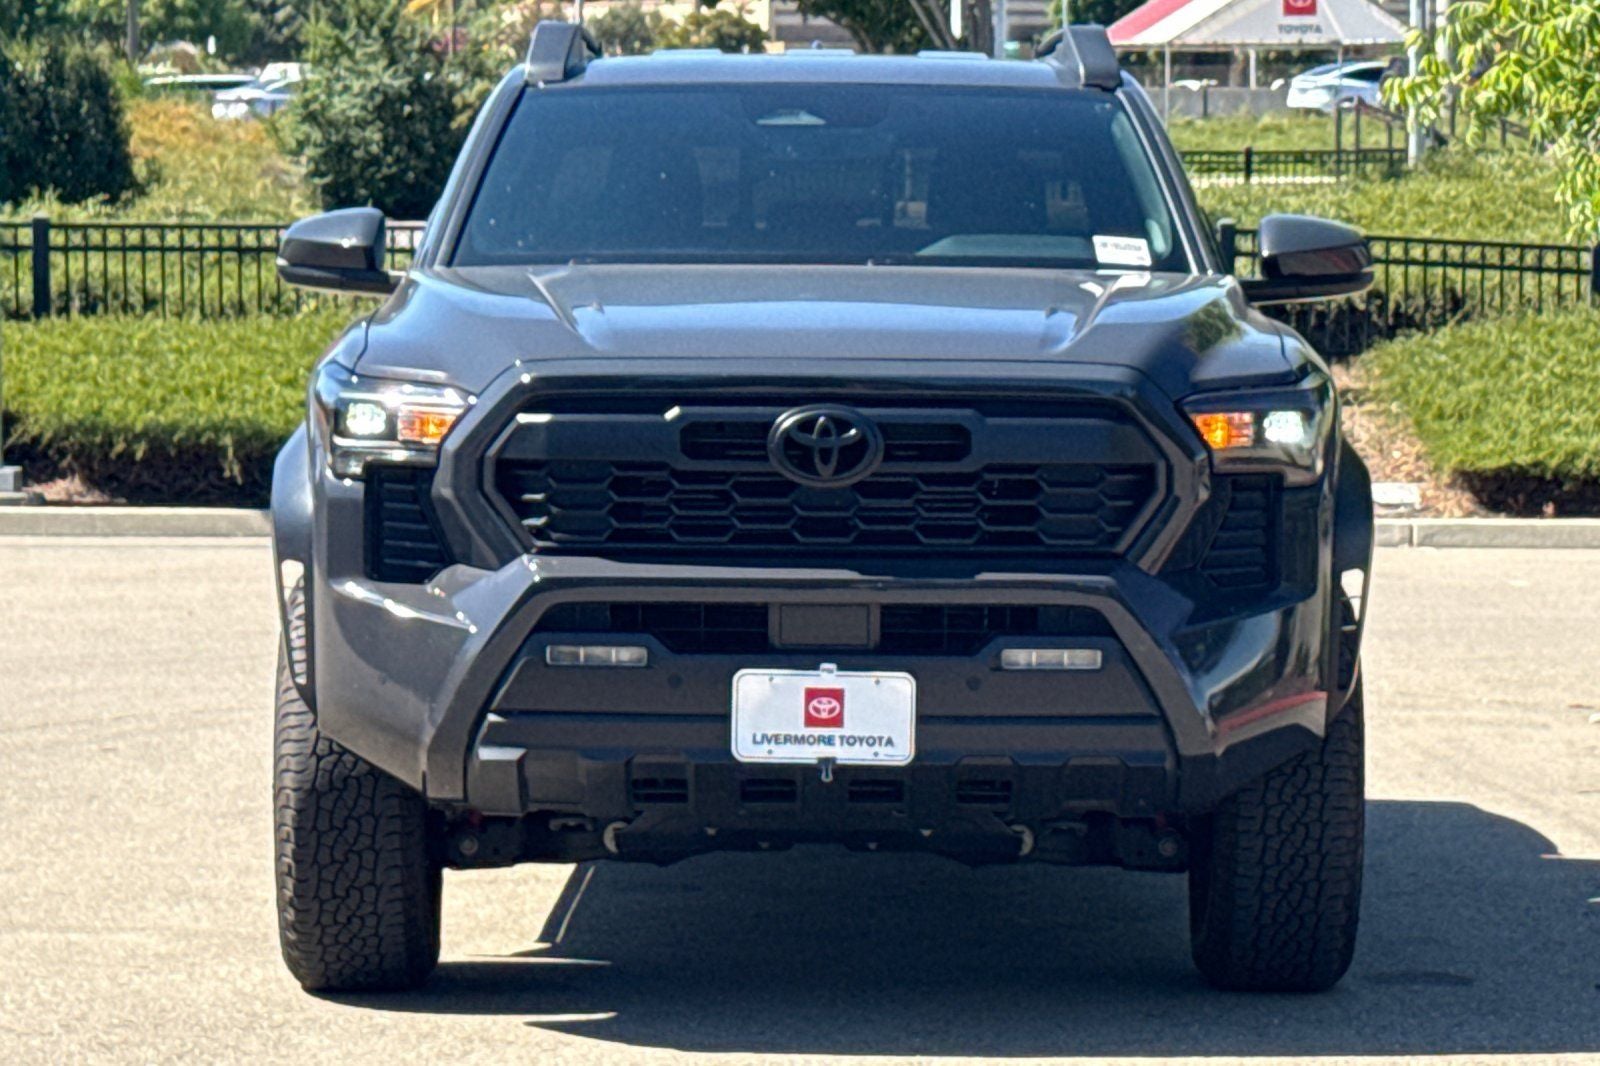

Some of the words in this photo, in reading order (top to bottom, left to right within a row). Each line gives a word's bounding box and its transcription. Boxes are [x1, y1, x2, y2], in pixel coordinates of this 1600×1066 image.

[1278, 24, 1322, 35] TOYOTA
[752, 733, 836, 746] LIVERMORE
[838, 735, 895, 747] TOYOTA
